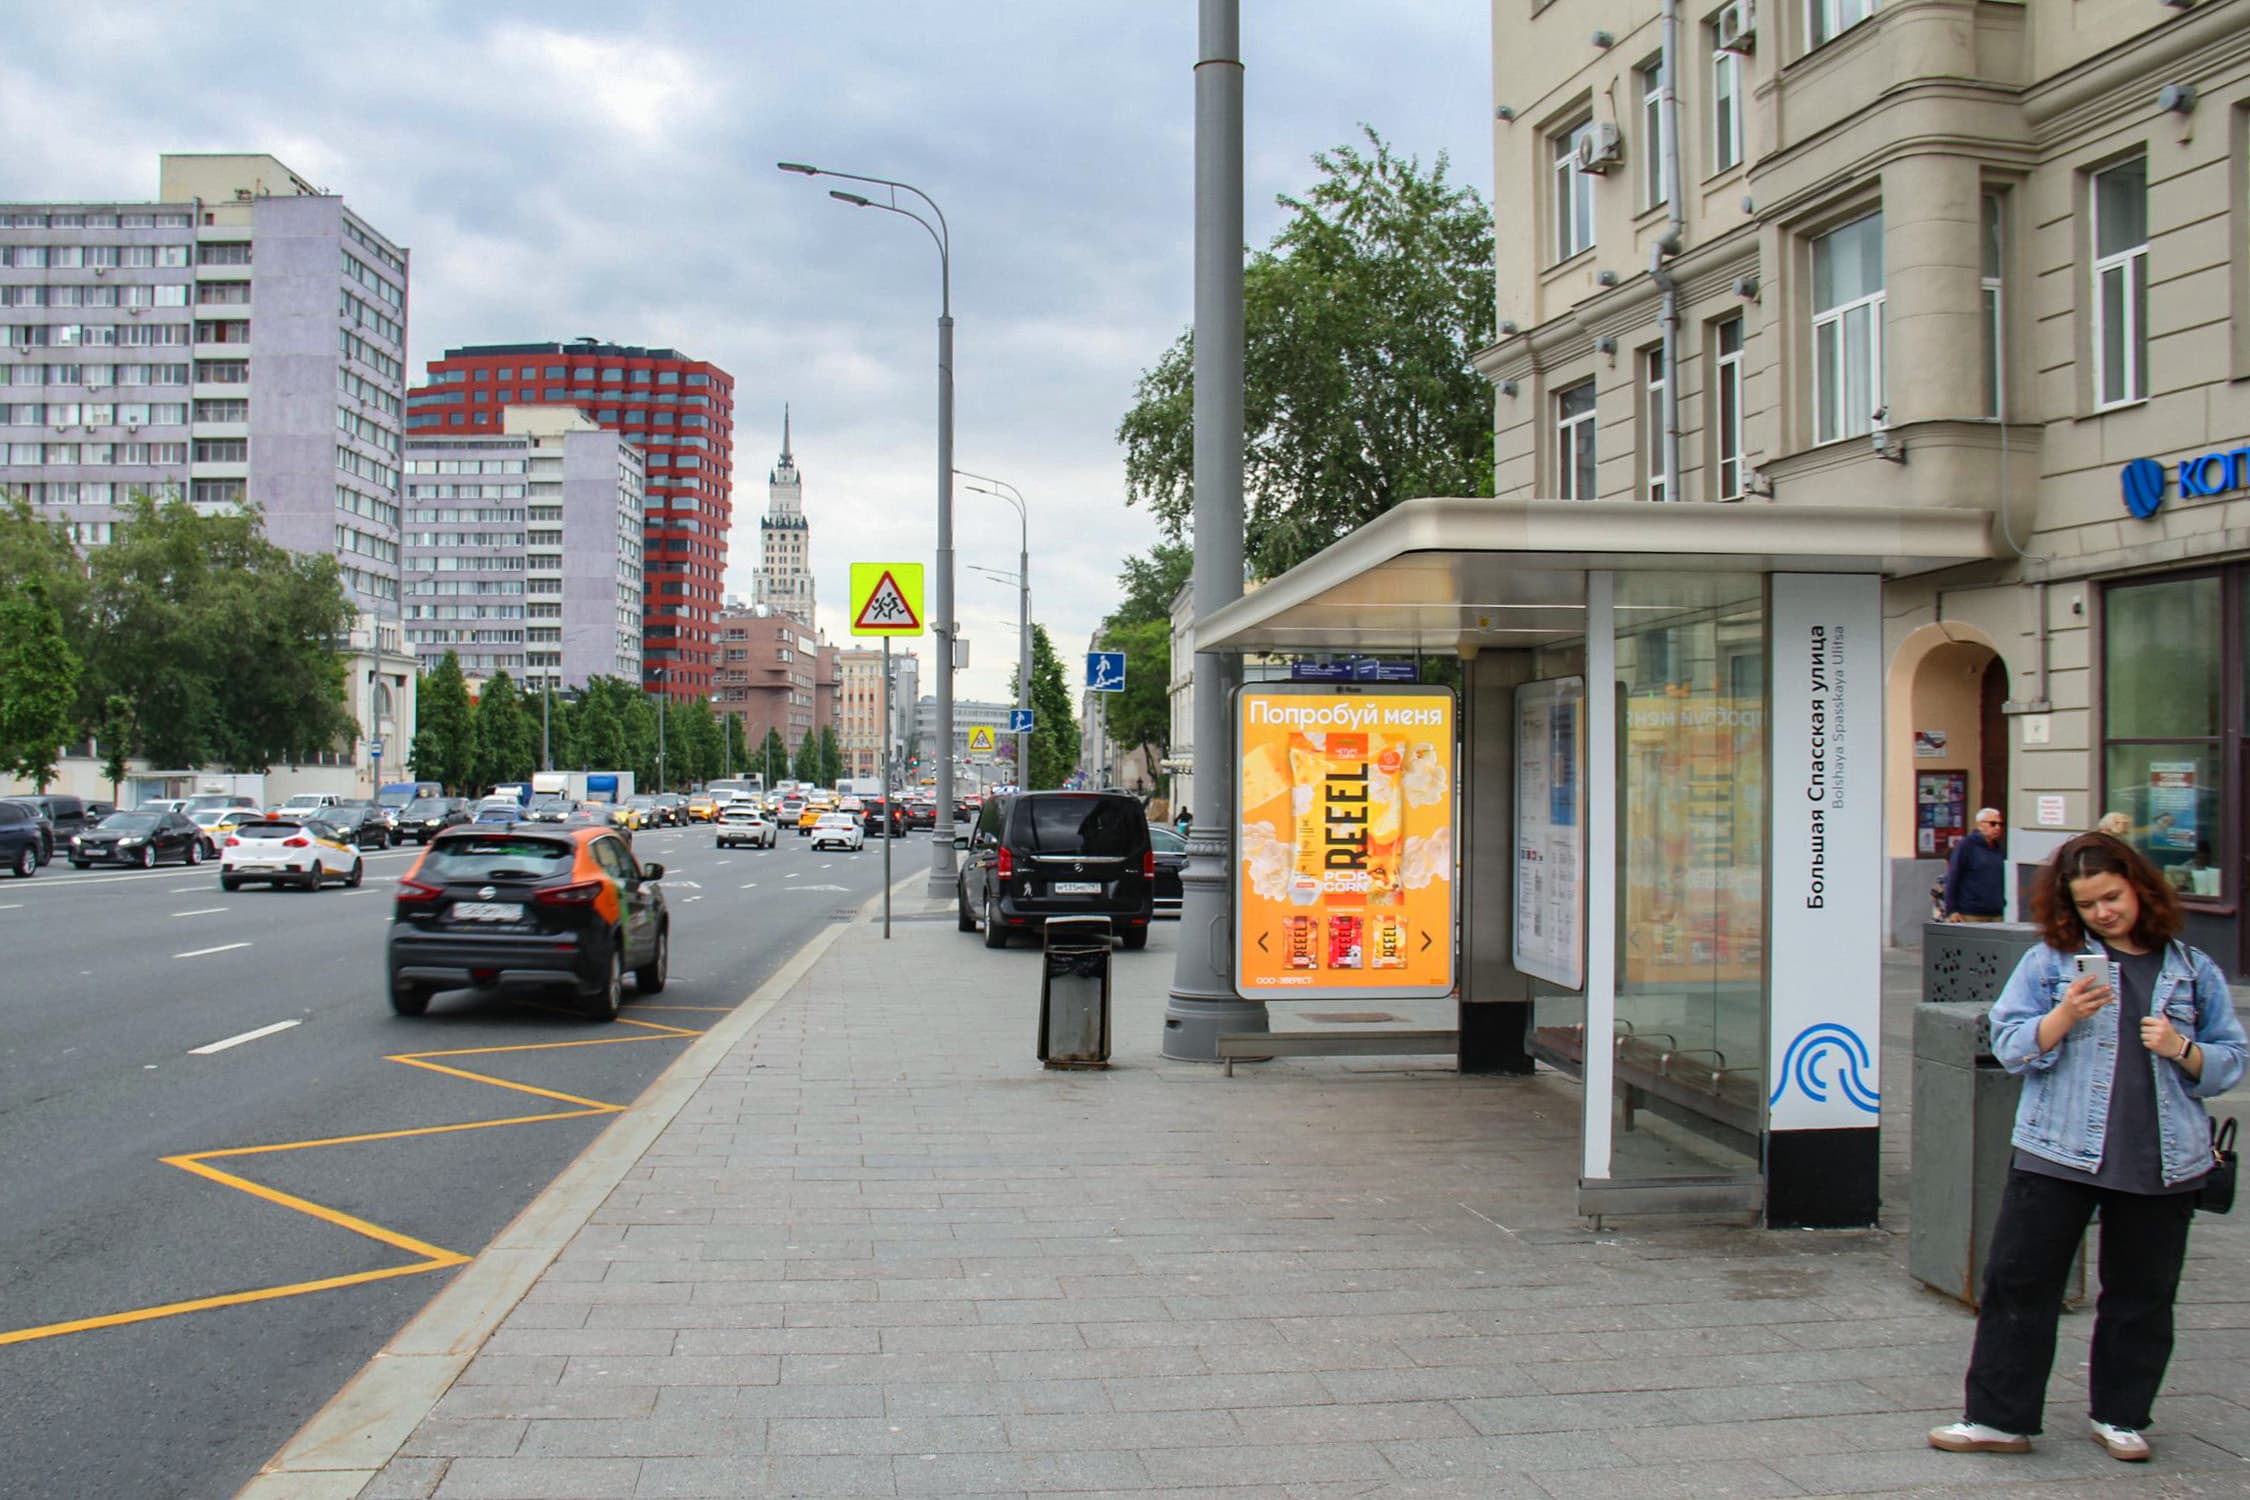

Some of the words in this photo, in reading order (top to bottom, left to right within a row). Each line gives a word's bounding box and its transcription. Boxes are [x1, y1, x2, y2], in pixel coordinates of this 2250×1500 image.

[1810, 625, 1828, 692] улица
[1832, 625, 1844, 665] Ulitsa
[1250, 700, 1378, 730] Попробуй
[1383, 707, 1442, 725] меня
[1832, 670, 1847, 742] Spasskaya
[1807, 699, 1824, 801] Спасская
[1832, 747, 1847, 809] Bolshaya
[1325, 763, 1368, 869] REEEL
[1324, 871, 1369, 881] POP
[1807, 811, 1824, 909] Большая
[1324, 882, 1369, 892] CORN
[1294, 927, 1307, 957] REEEL
[1383, 925, 1397, 957] REEEL
[1256, 976, 1276, 984] ООО
